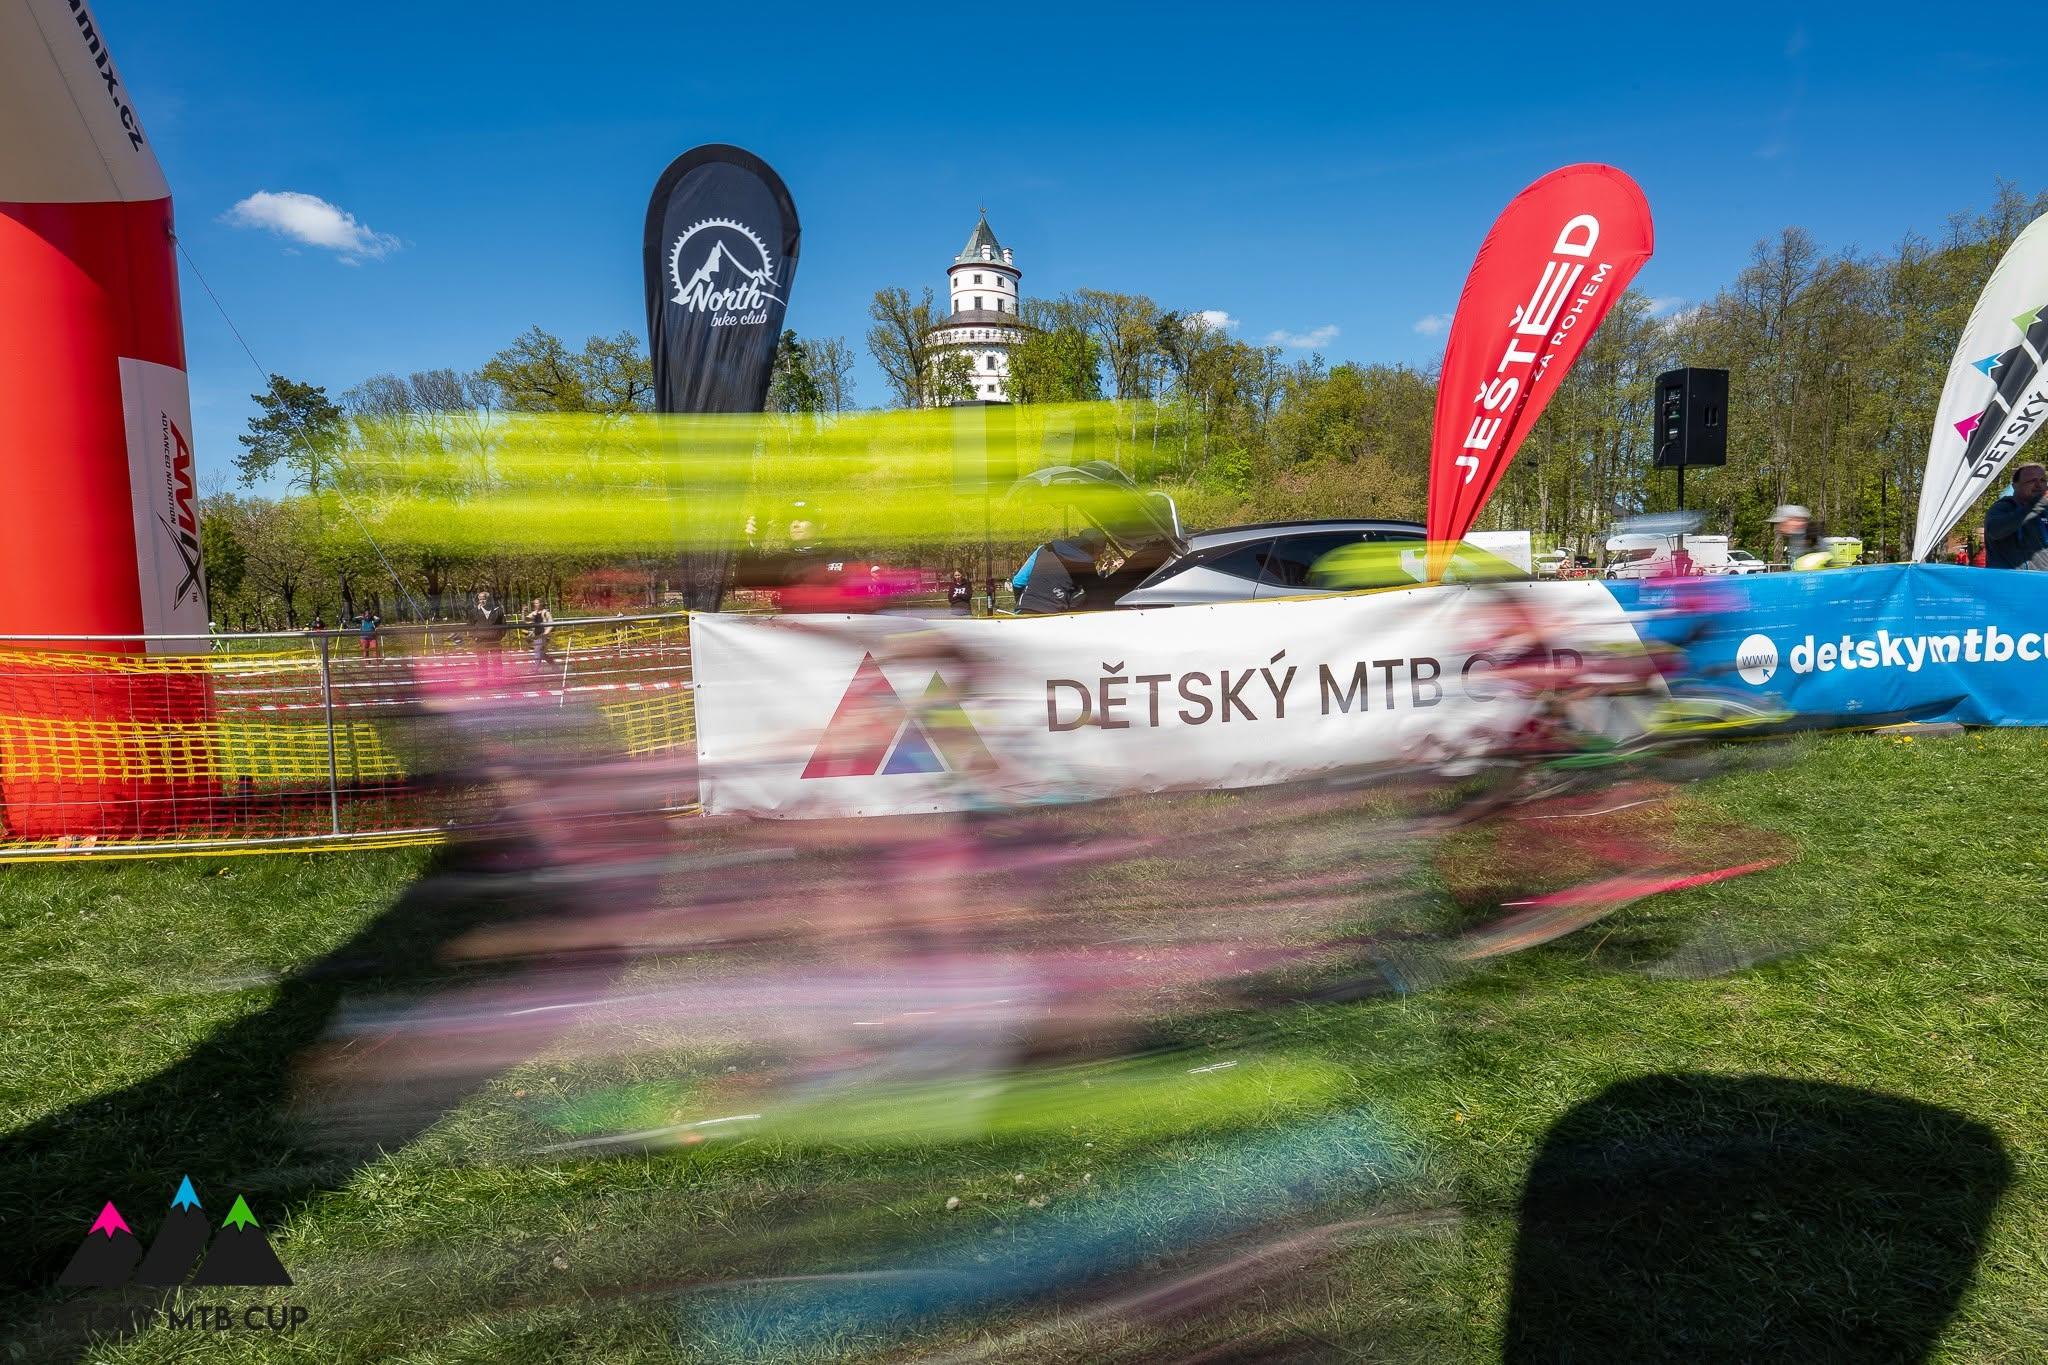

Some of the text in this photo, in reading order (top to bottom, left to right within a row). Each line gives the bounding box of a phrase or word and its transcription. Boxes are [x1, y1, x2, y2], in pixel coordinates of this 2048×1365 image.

[688, 277, 765, 313] North
[710, 309, 768, 327] bike club
[1550, 263, 1613, 346] ROHEM
[1455, 213, 1600, 485] JEŠTĚD
[160, 409, 177, 525] ADVANCED NUTRITION
[156, 418, 207, 612] AMIX
[1046, 648, 1584, 732] DĚTSKÝ MTB CP
[1742, 652, 1774, 667] www
[1789, 625, 2048, 674] detskymtbc
